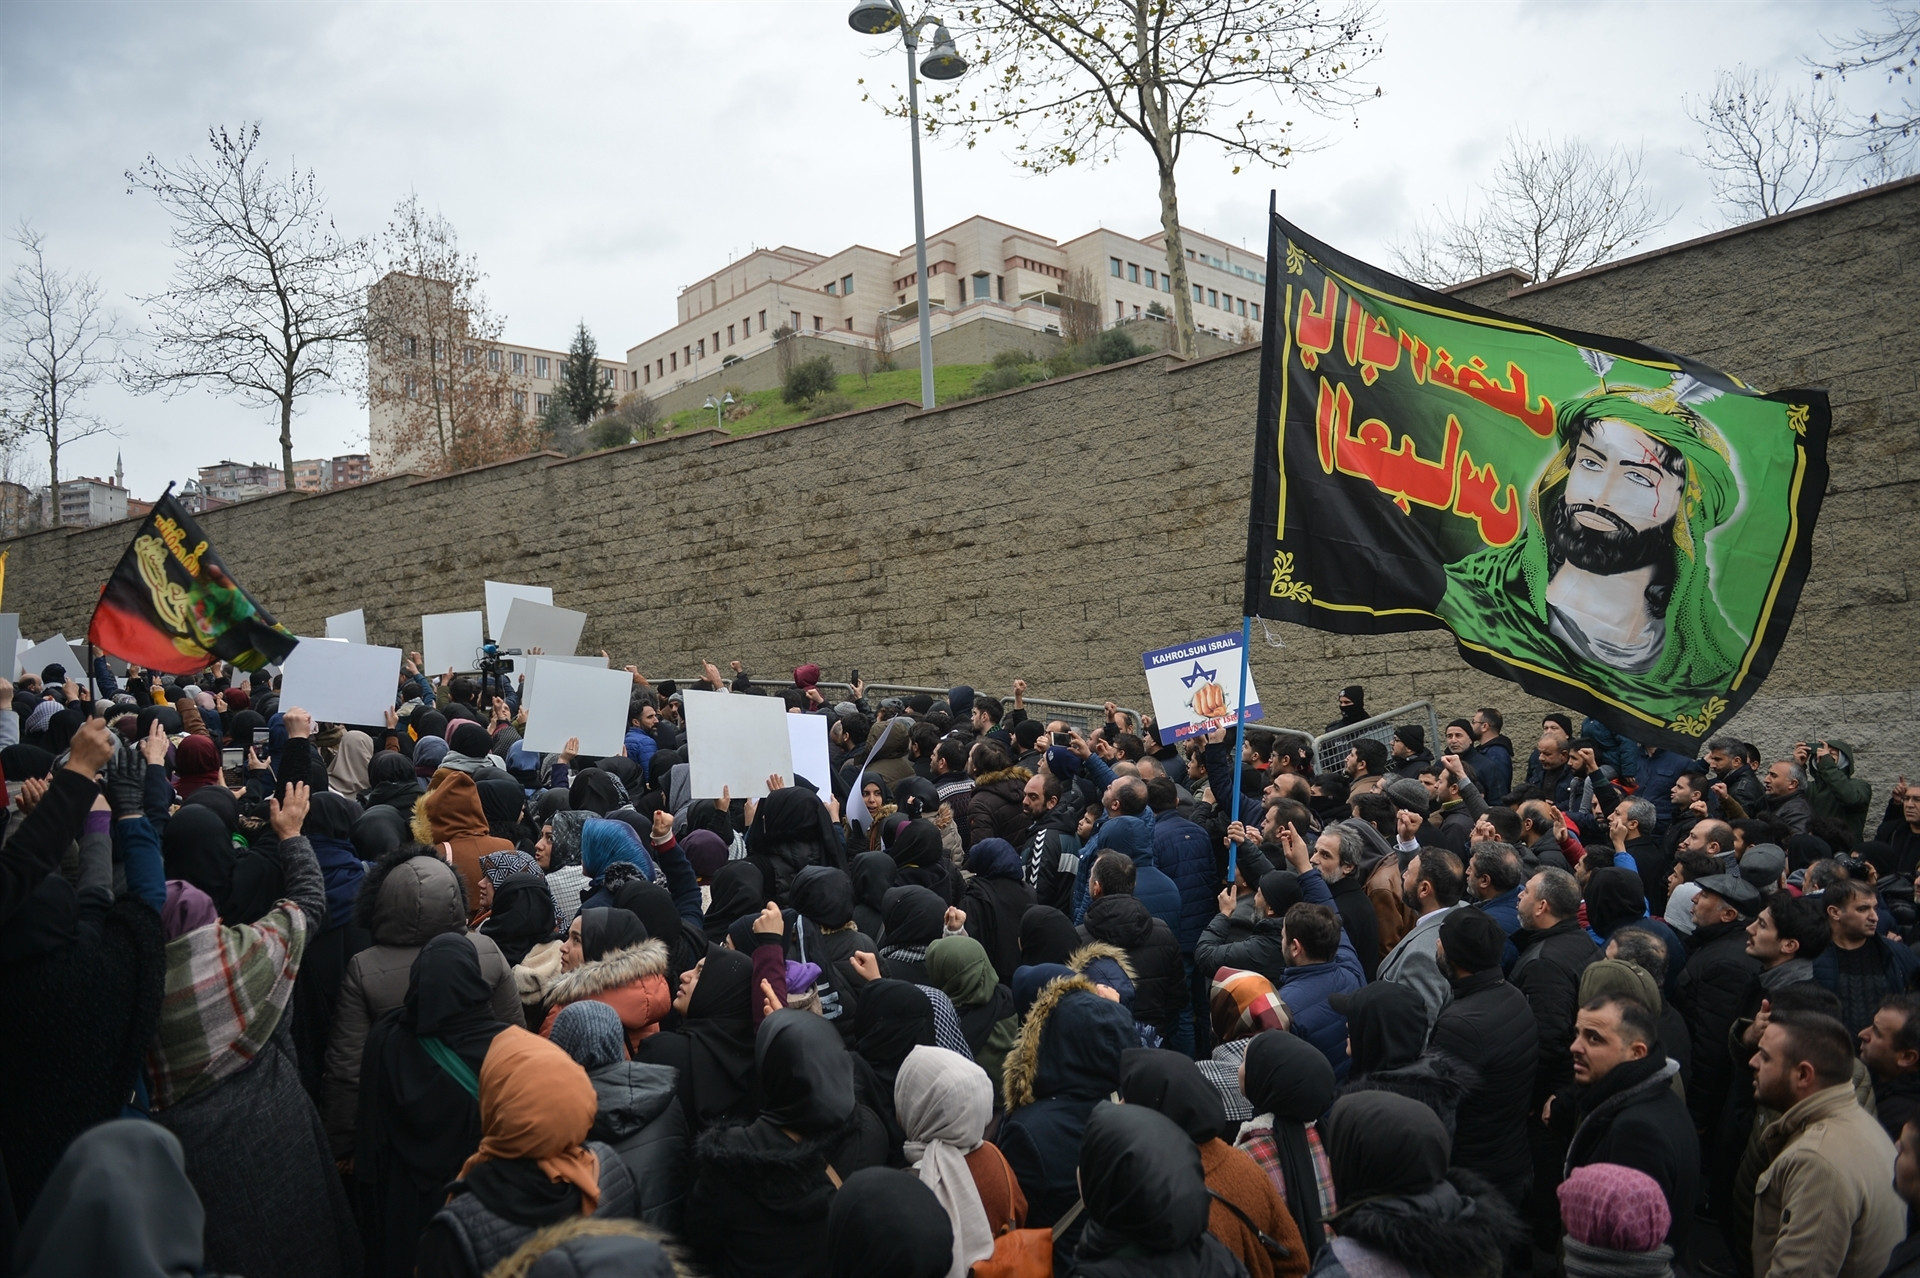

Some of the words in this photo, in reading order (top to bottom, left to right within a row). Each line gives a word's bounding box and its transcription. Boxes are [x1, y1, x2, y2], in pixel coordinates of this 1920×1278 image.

[1151, 645, 1207, 665] KAHROLSUN
[1175, 723, 1199, 737] DOWN
[1223, 709, 1252, 724] ISRL
